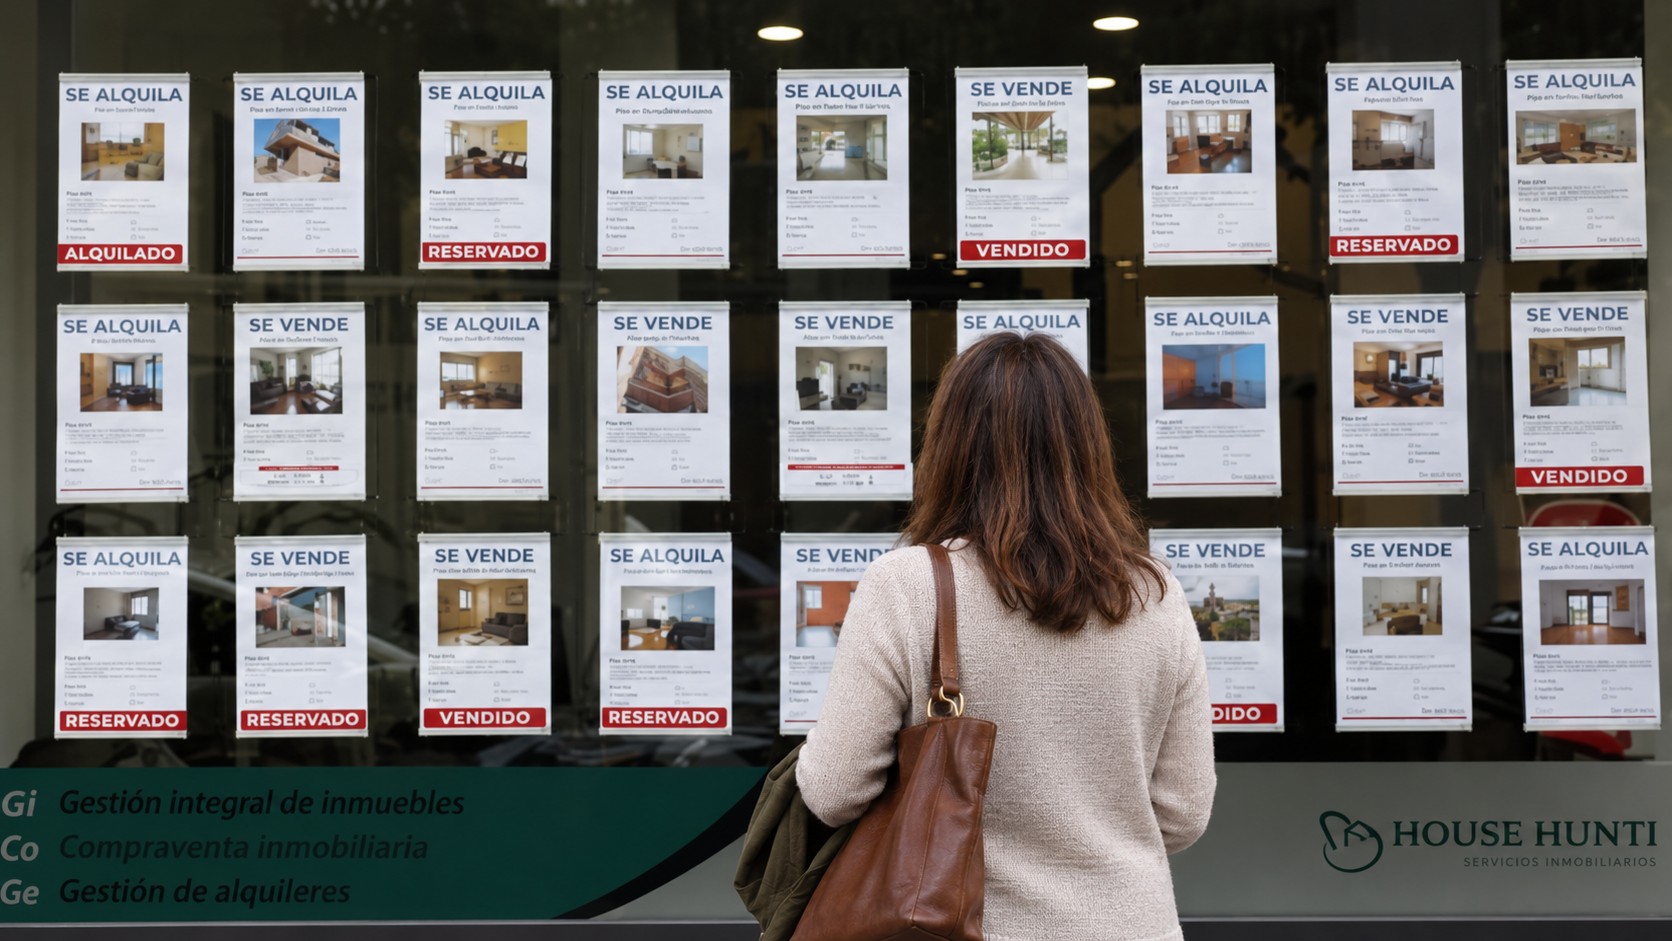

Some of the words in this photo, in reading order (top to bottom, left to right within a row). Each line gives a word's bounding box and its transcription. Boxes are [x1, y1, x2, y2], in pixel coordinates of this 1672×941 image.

[970, 82, 995, 97] SE
[1001, 81, 1073, 96] VENDE
[1148, 79, 1173, 94] SE
[1178, 78, 1268, 96] ALQUILA
[1334, 77, 1359, 92] SE
[1365, 76, 1455, 94] ALQUILA
[1514, 74, 1539, 89] SE
[1545, 72, 1636, 90] ALQUILA
[66, 87, 90, 102] SE
[95, 87, 183, 104] ALQUILA
[240, 87, 265, 102] SE
[270, 86, 358, 104] ALQUILA
[428, 85, 452, 100] SE
[457, 85, 546, 102] ALQUILA
[606, 85, 630, 100] SE
[636, 84, 724, 102] ALQUILA
[784, 84, 809, 99] SE
[814, 83, 902, 101] ALQUILA
[428, 244, 539, 259] RESERVADO
[975, 242, 1070, 258] VENDIDO
[1336, 237, 1451, 253] RESERVADO
[64, 246, 176, 262] ALQUILADO
[1153, 312, 1178, 326] SE
[1183, 311, 1271, 328] ALQUILA
[1347, 310, 1372, 325] SE
[1378, 308, 1449, 324] VENDE
[1526, 307, 1552, 322] SE
[1557, 306, 1629, 322] VENDE
[63, 319, 88, 334] SE
[93, 319, 182, 336] ALQUILA
[249, 318, 274, 333] SE
[279, 317, 349, 332] VENDE
[424, 317, 448, 332] SE
[454, 317, 540, 333] ALQUILA
[614, 316, 638, 331] SE
[643, 316, 713, 330] VENDE
[794, 315, 819, 330] SE
[825, 315, 894, 330] VENDE
[963, 315, 987, 330] SE
[993, 314, 1081, 331] ALQUILA
[1530, 469, 1628, 484] VENDIDO
[435, 548, 459, 563] SE
[465, 548, 534, 563] VENDE
[610, 548, 634, 563] SE
[640, 548, 725, 565] ALQUILA
[796, 548, 821, 563] SE
[1165, 544, 1190, 559] SE
[1196, 543, 1266, 558] VENDE
[1350, 543, 1376, 558] SE
[1381, 542, 1453, 558] VENDE
[1527, 542, 1553, 557] SE
[1558, 541, 1649, 558] ALQUILA
[63, 551, 87, 566] SE
[94, 551, 181, 568] ALQUILA
[250, 551, 275, 566] SE
[280, 550, 350, 566] VENDE
[65, 713, 180, 728] RESERVADO
[247, 712, 360, 727] RESERVADO
[439, 710, 531, 725] VENDIDO
[608, 710, 720, 725] RESERVADO
[1211, 706, 1261, 721] DIDO
[2, 790, 37, 817] Gi
[60, 788, 162, 815] Gestión
[169, 789, 273, 820] integral
[279, 789, 314, 815] de
[321, 789, 466, 815] inmuebles
[1392, 819, 1524, 847] HOUSE
[1533, 819, 1658, 847] HUNTI
[0, 834, 39, 861] Co
[60, 834, 249, 864] Compraventa
[258, 834, 429, 860] inmobiliaria
[1463, 856, 1540, 868] SERVICIOS
[1545, 856, 1657, 868] INMOBILIARIOS
[0, 878, 39, 905] Ge
[60, 877, 165, 905] Gestión
[173, 877, 208, 905] de
[214, 877, 352, 909] alquileres
